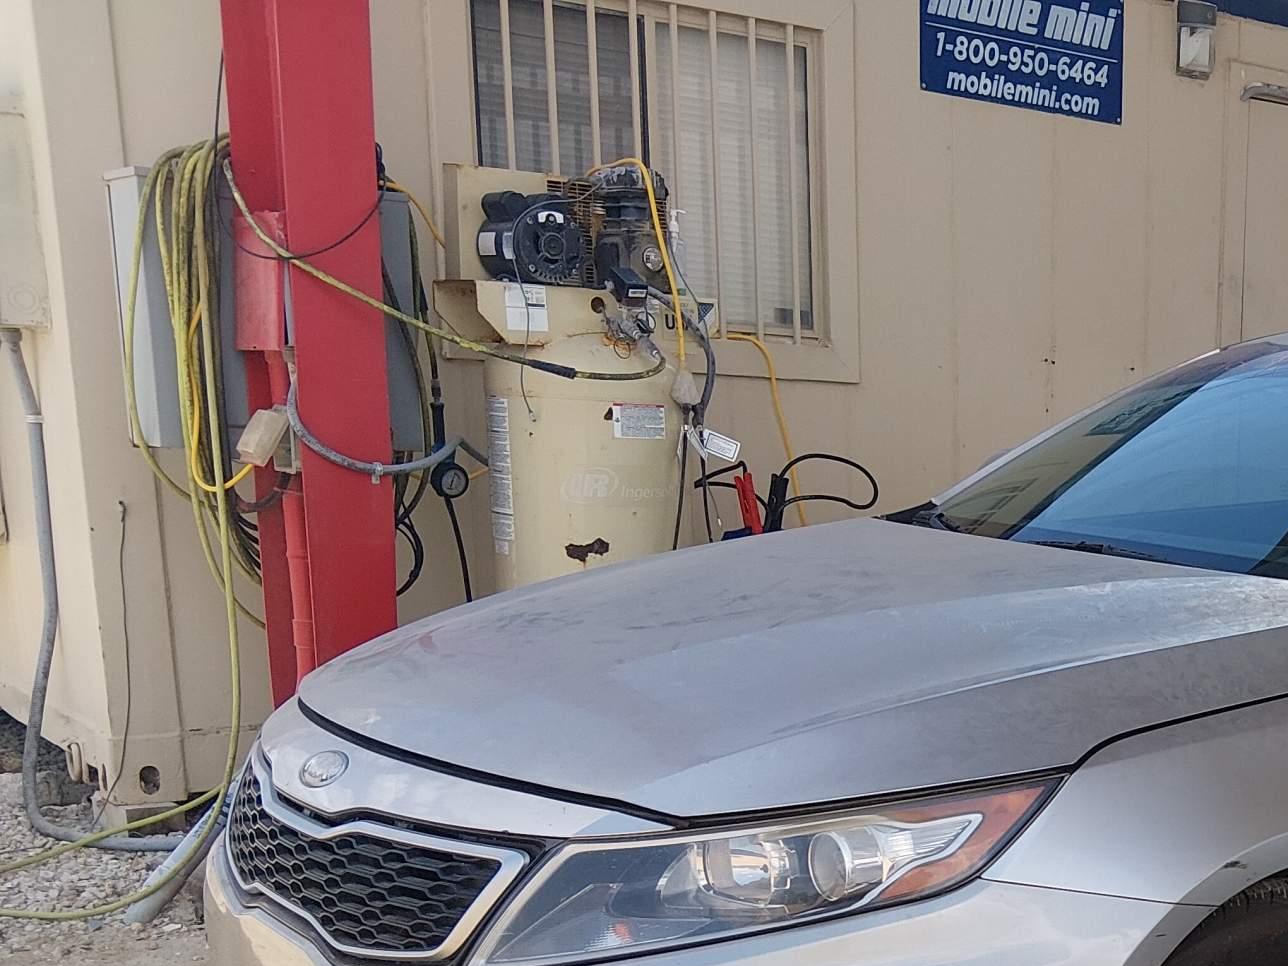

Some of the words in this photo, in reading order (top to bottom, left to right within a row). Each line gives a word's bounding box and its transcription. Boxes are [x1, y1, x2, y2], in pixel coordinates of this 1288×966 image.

[1044, 2, 1118, 50] mini
[936, 32, 1109, 87] 1-800-950-6464
[946, 71, 1100, 115] mobilemini.com
